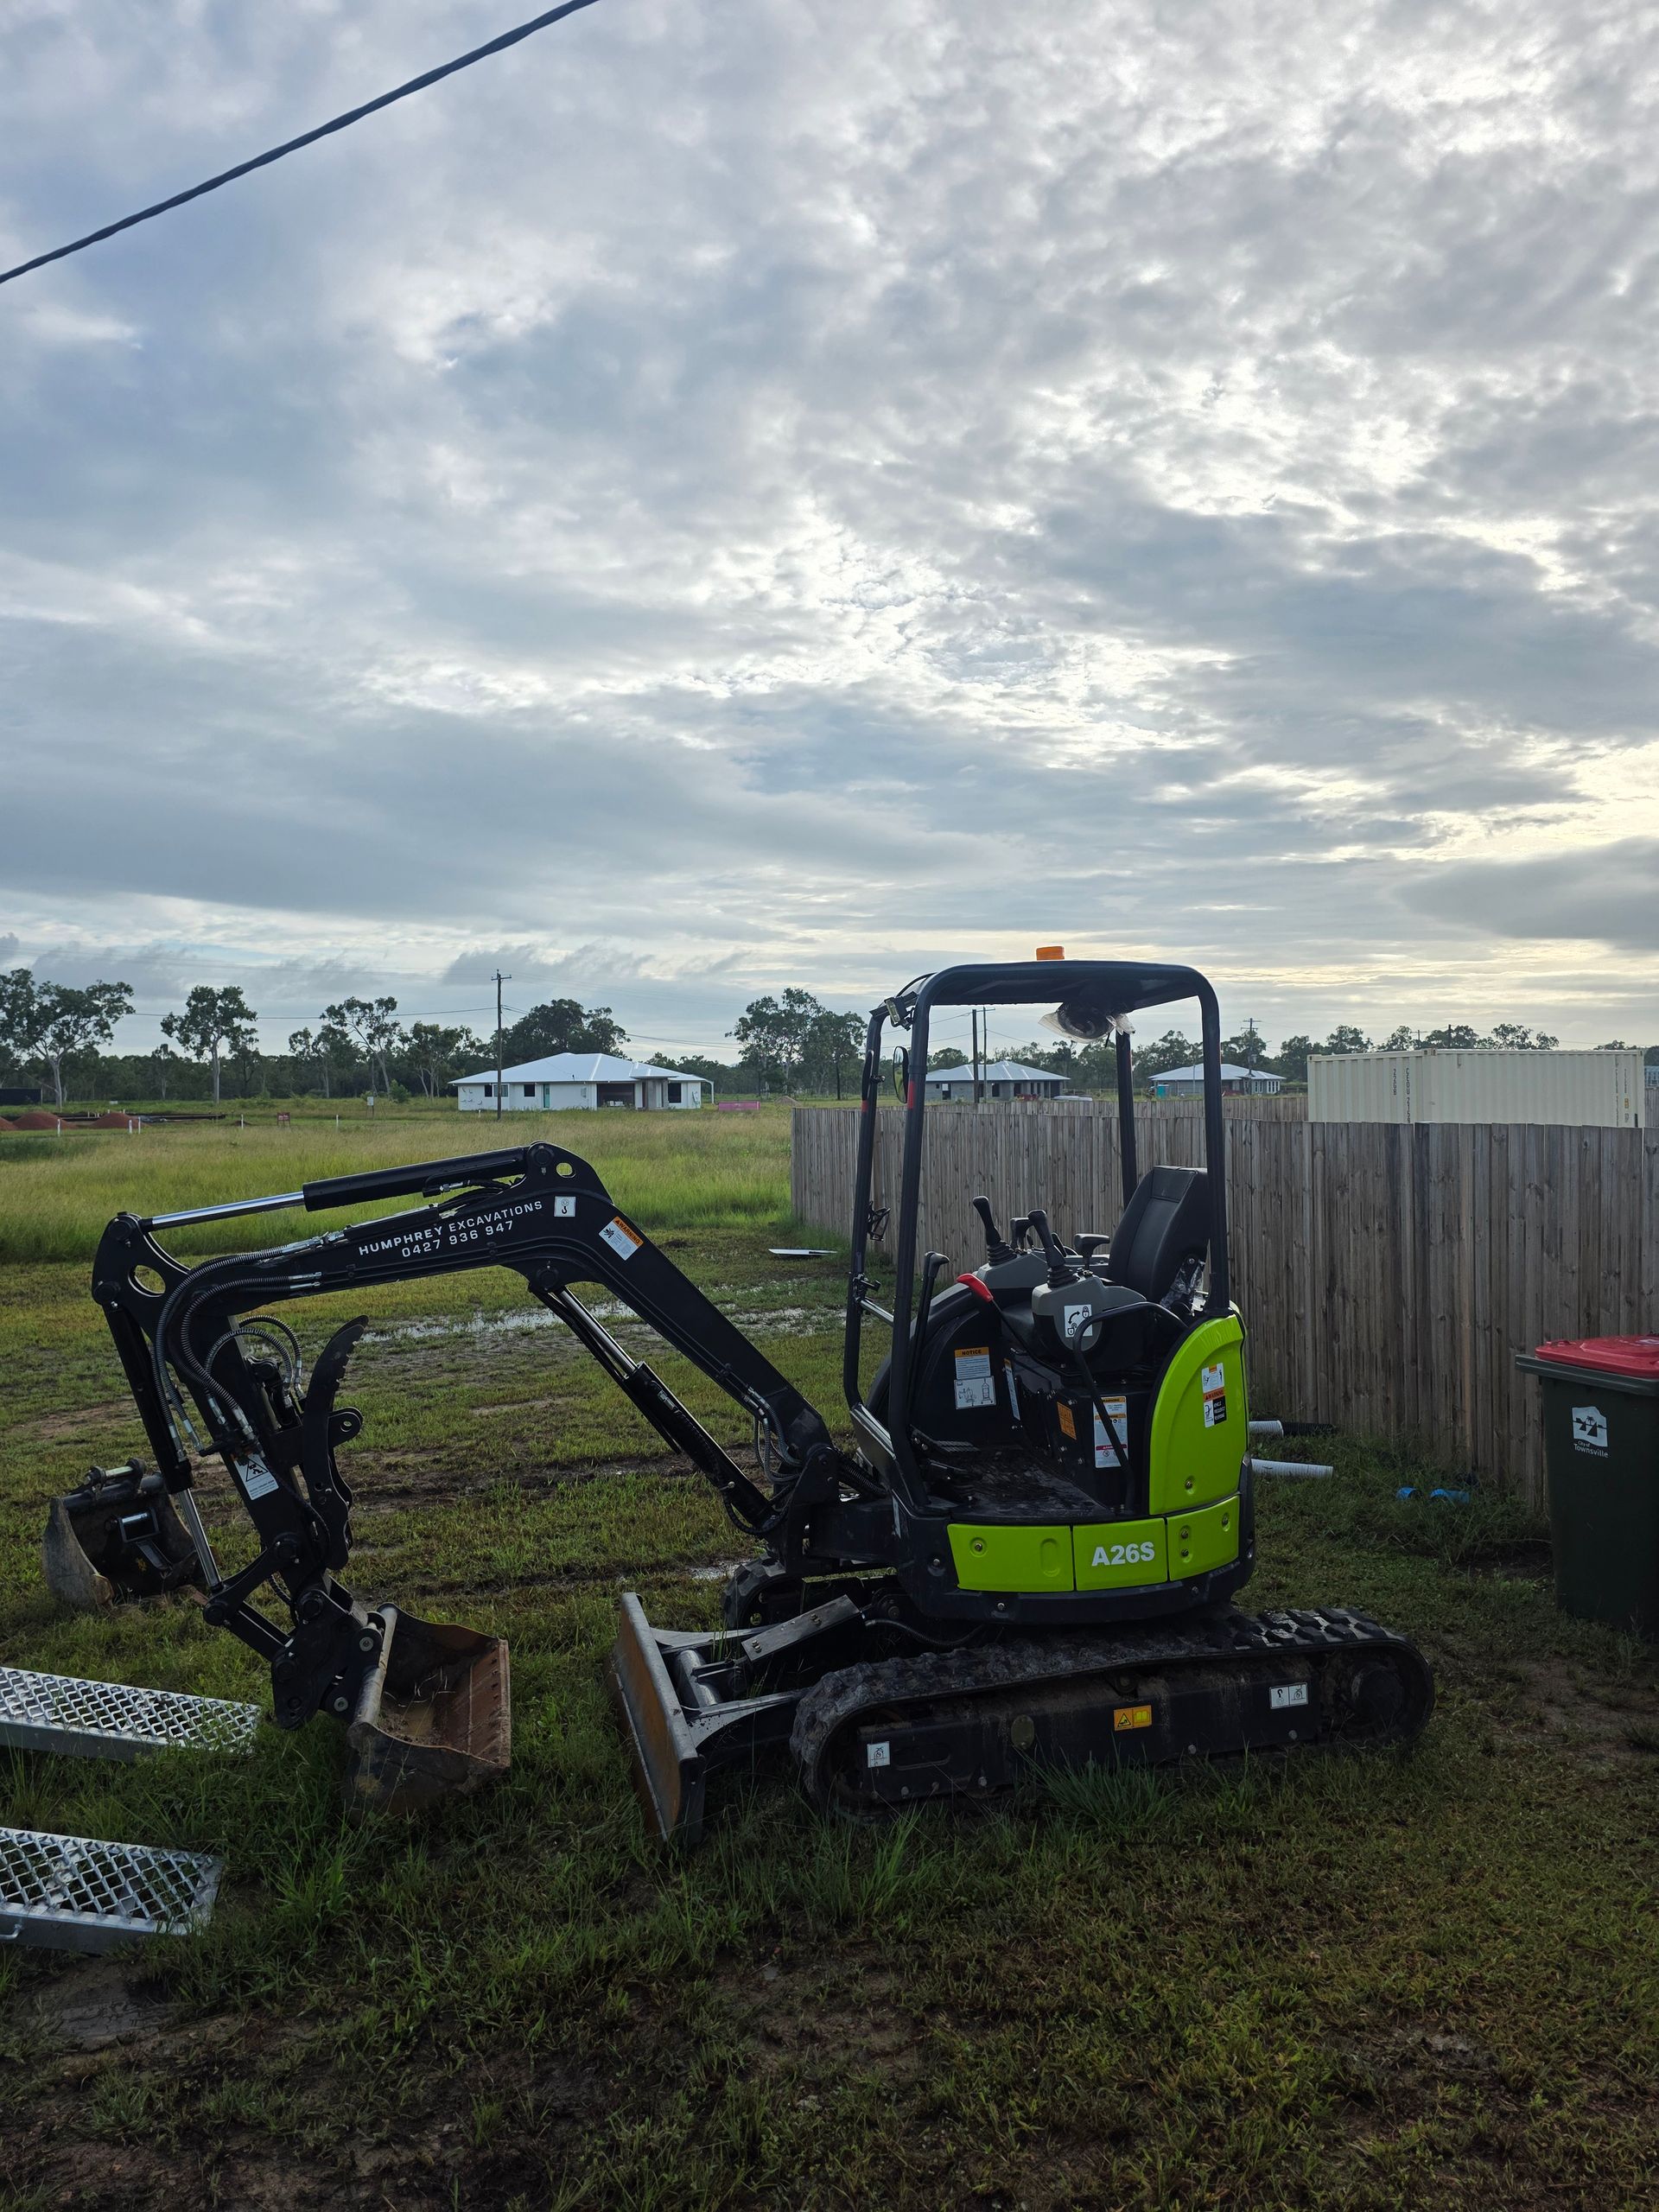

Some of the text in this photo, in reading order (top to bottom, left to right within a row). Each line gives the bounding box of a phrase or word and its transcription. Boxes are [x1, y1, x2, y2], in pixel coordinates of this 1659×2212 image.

[359, 1201, 543, 1255] HUMPHREY EXCAVATIONS
[402, 1220, 513, 1257] 0427 936 947
[619, 1223, 640, 1244] WARNING
[1573, 1443, 1609, 1458] Townsville
[1091, 1541, 1155, 1567] A26S
